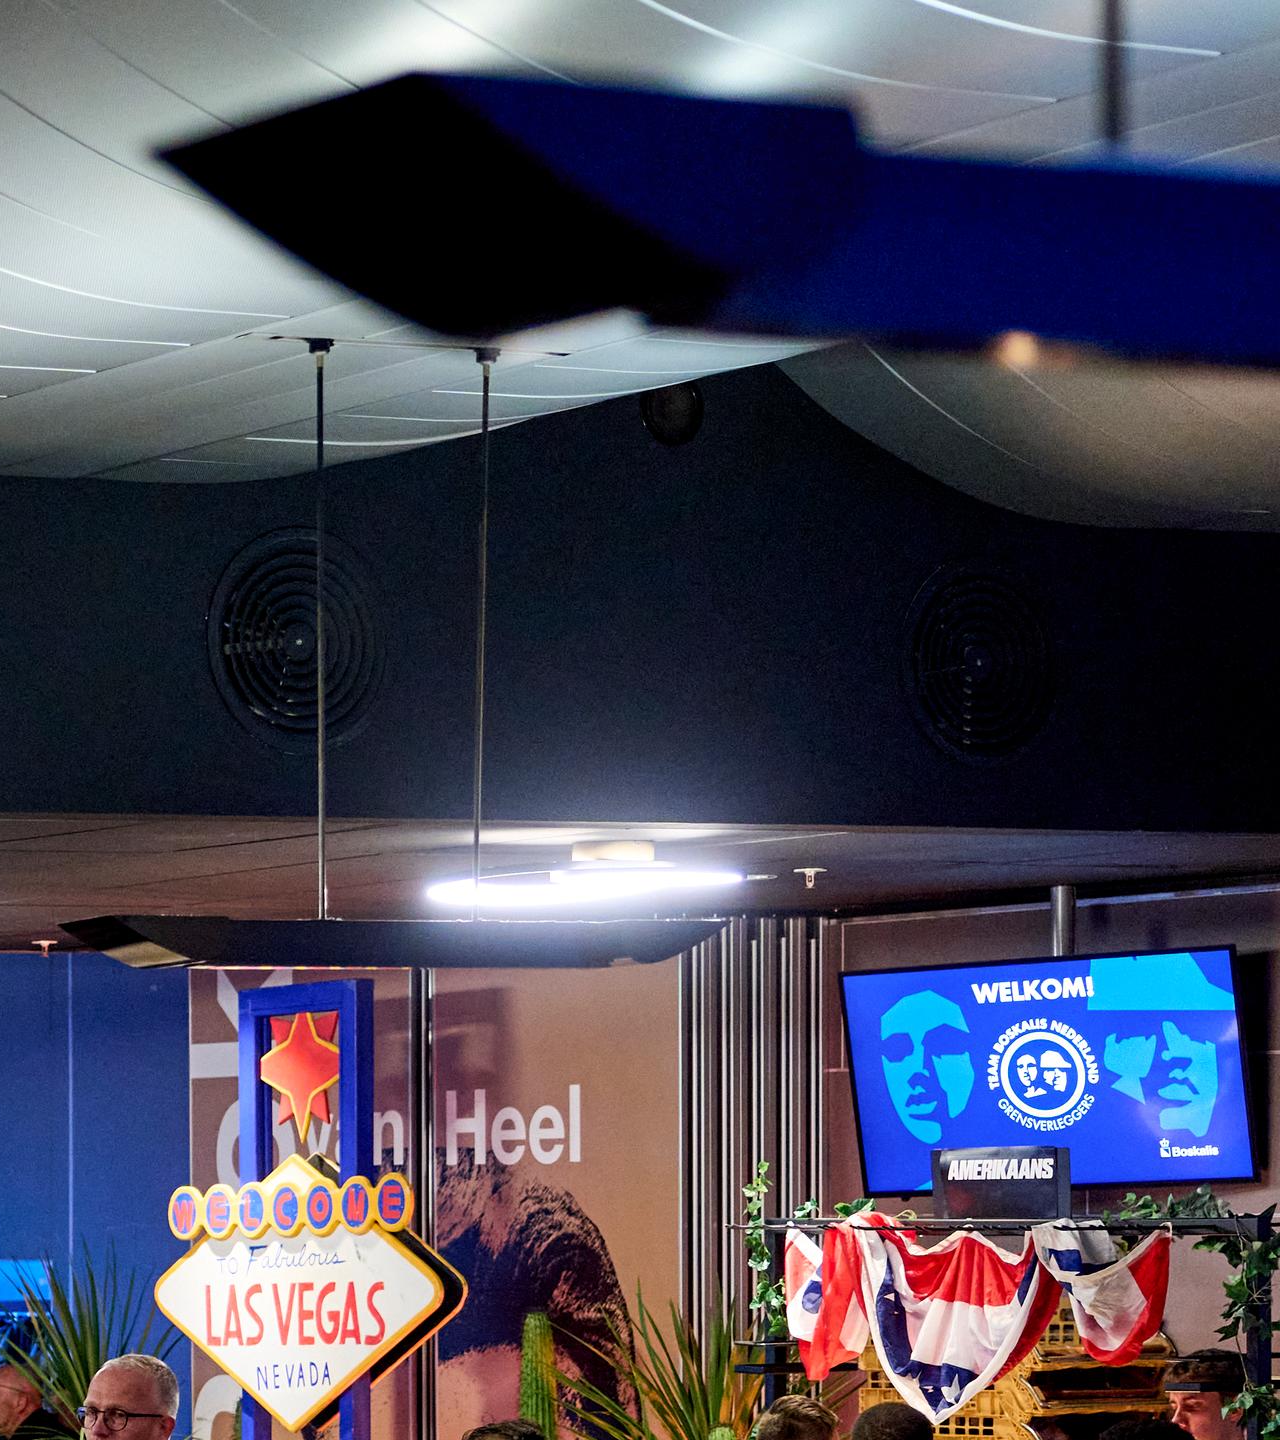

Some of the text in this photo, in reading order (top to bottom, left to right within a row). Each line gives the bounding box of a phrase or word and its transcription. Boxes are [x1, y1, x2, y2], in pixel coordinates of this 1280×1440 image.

[971, 975, 1096, 1005] WELKOM!
[987, 1018, 1100, 1091] TEAM BOSKALIS NEDERLAND
[444, 1084, 582, 1166] Heel
[998, 1093, 1096, 1132] GRENSVERLEGGERS
[947, 1157, 1055, 1181] AMERIKAANS
[1172, 1144, 1219, 1158] Boskalis
[172, 1185, 402, 1233] WELCOME
[247, 1244, 346, 1277] Fabulous
[206, 1281, 385, 1346] LAS VEGAS
[256, 1361, 332, 1391] NEVADA
